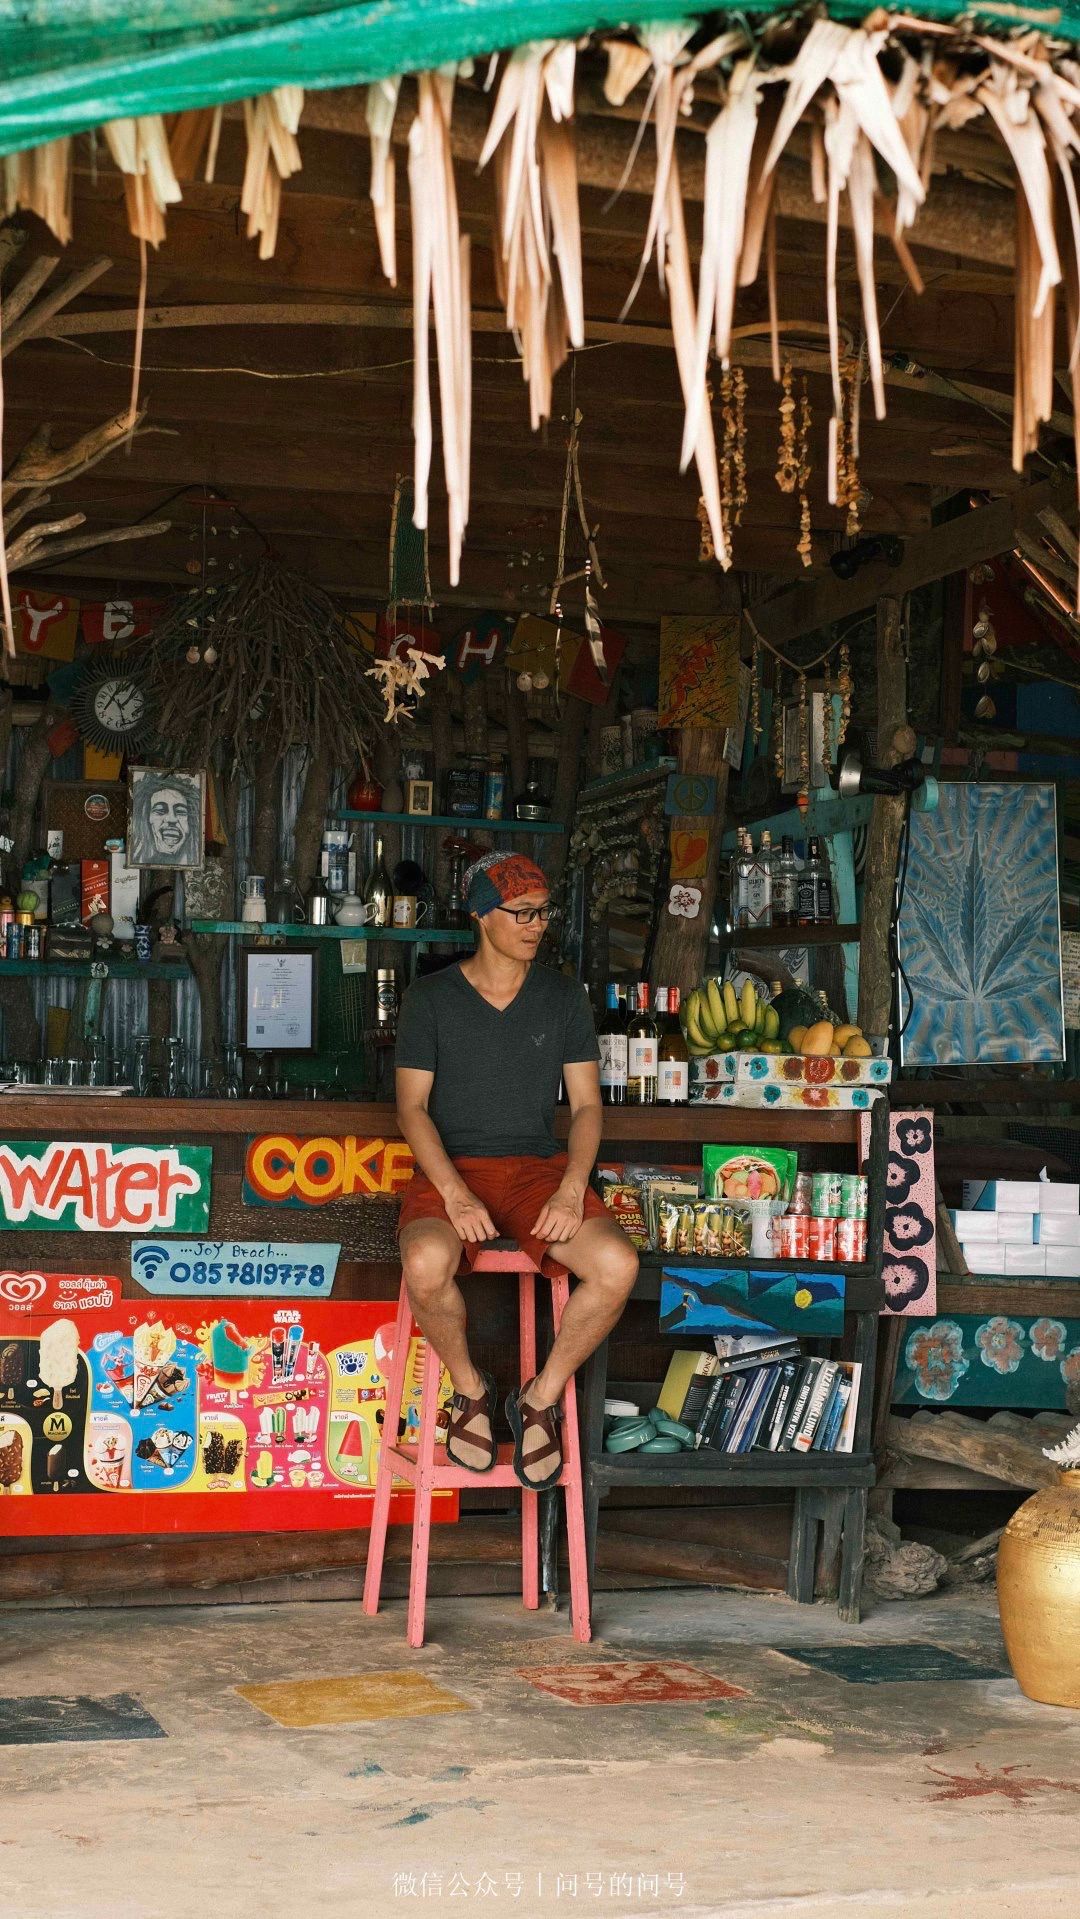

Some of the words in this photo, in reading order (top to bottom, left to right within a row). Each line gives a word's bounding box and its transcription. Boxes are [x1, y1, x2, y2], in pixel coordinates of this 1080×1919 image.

[25, 594, 63, 642] Y
[459, 631, 498, 668] H
[169, 1261, 325, 1287] 0857819778
[49, 1417, 66, 1431] M
[785, 1422, 797, 1439] LIZA
[793, 1385, 811, 1424] MARKLUND
